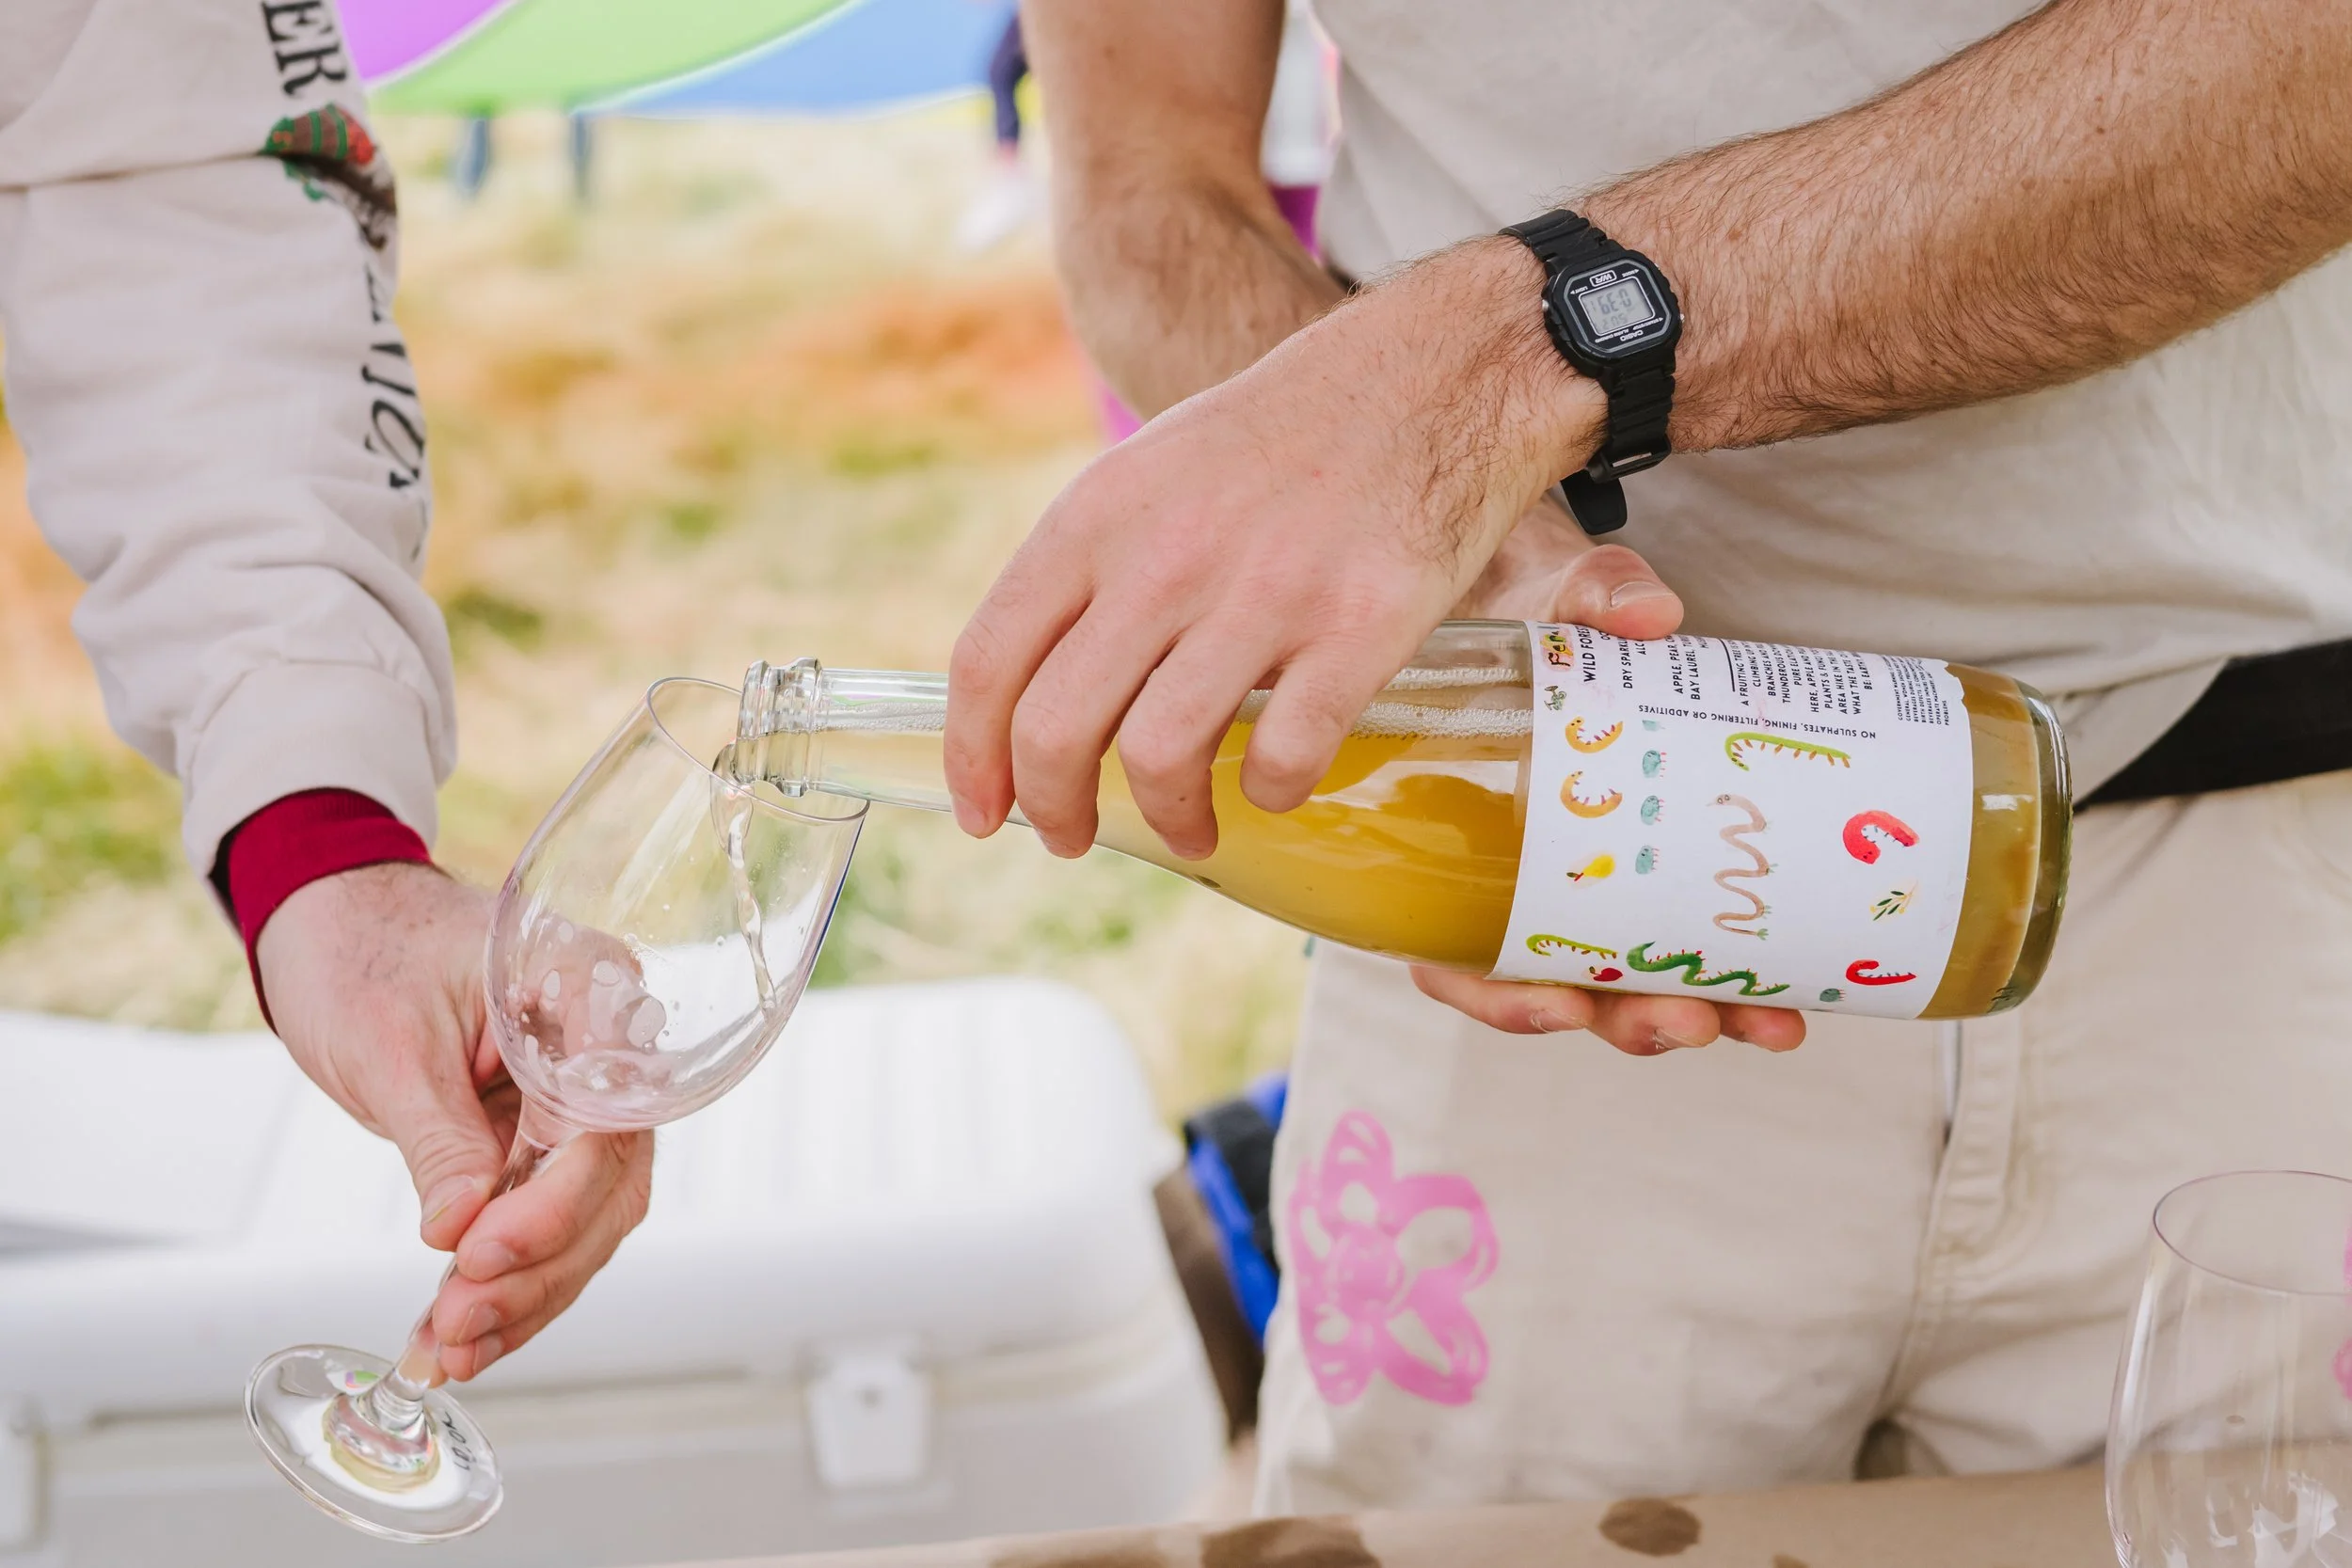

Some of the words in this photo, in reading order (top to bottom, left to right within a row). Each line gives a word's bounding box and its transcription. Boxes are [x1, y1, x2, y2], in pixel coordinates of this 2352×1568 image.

[1595, 274, 1612, 283] WR
[1620, 330, 1644, 341] CASIO
[1635, 643, 1646, 655] ALC
[1732, 650, 1742, 661] TREE
[1582, 653, 1596, 682] WILD
[1748, 656, 1761, 687] CLIMBING
[1791, 669, 1803, 686] PURE
[1804, 667, 1817, 687] APPLE
[1622, 669, 1632, 689] DRY
[1671, 664, 1683, 694] APPLE,
[1736, 663, 1748, 697] FRUITING
[1763, 660, 1775, 696] BRANCHES
[1774, 657, 1790, 704] THUNDEROUS
[1834, 674, 1845, 689] HIKE
[1848, 676, 1859, 688] THE
[1864, 679, 1872, 689] BE:
[1690, 680, 1700, 700] BAY
[1821, 679, 1833, 708] PLANTS
[1809, 689, 1820, 712] HERE,
[1837, 693, 1848, 714] AREA
[1851, 691, 1861, 714] WHAT
[1926, 698, 1934, 723] BEVERAGES
[1638, 705, 1689, 717] ADDITIVES
[1692, 711, 1707, 720] OR
[1710, 713, 1758, 725] FILTERING
[1761, 718, 1797, 730] FINING,
[1861, 730, 1876, 738] NO
